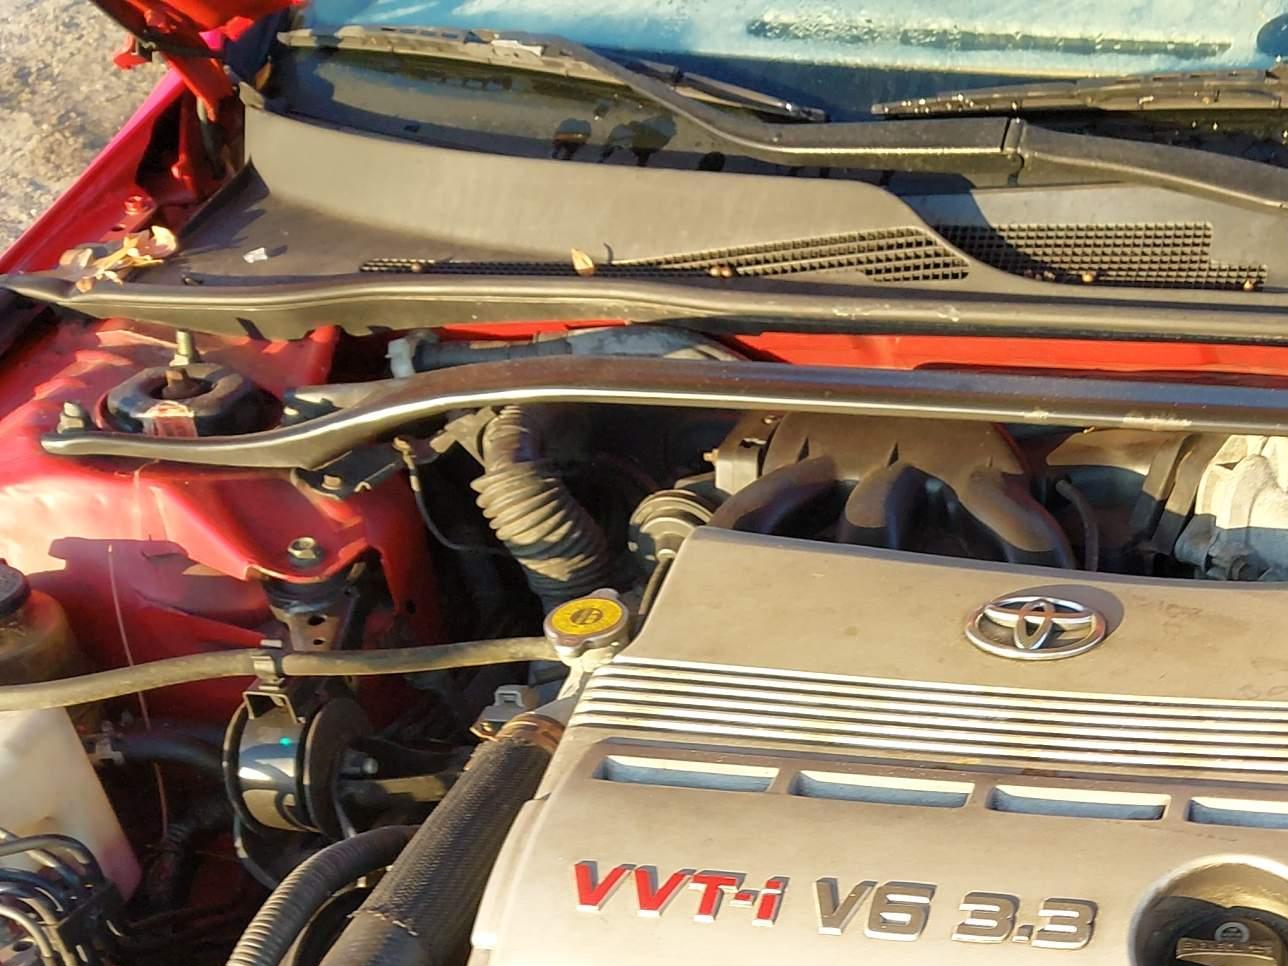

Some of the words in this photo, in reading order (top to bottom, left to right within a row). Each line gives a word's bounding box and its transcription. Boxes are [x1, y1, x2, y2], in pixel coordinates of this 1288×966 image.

[574, 860, 790, 928] VVT-i
[812, 875, 938, 942] V6
[951, 890, 1099, 950] 3.3
